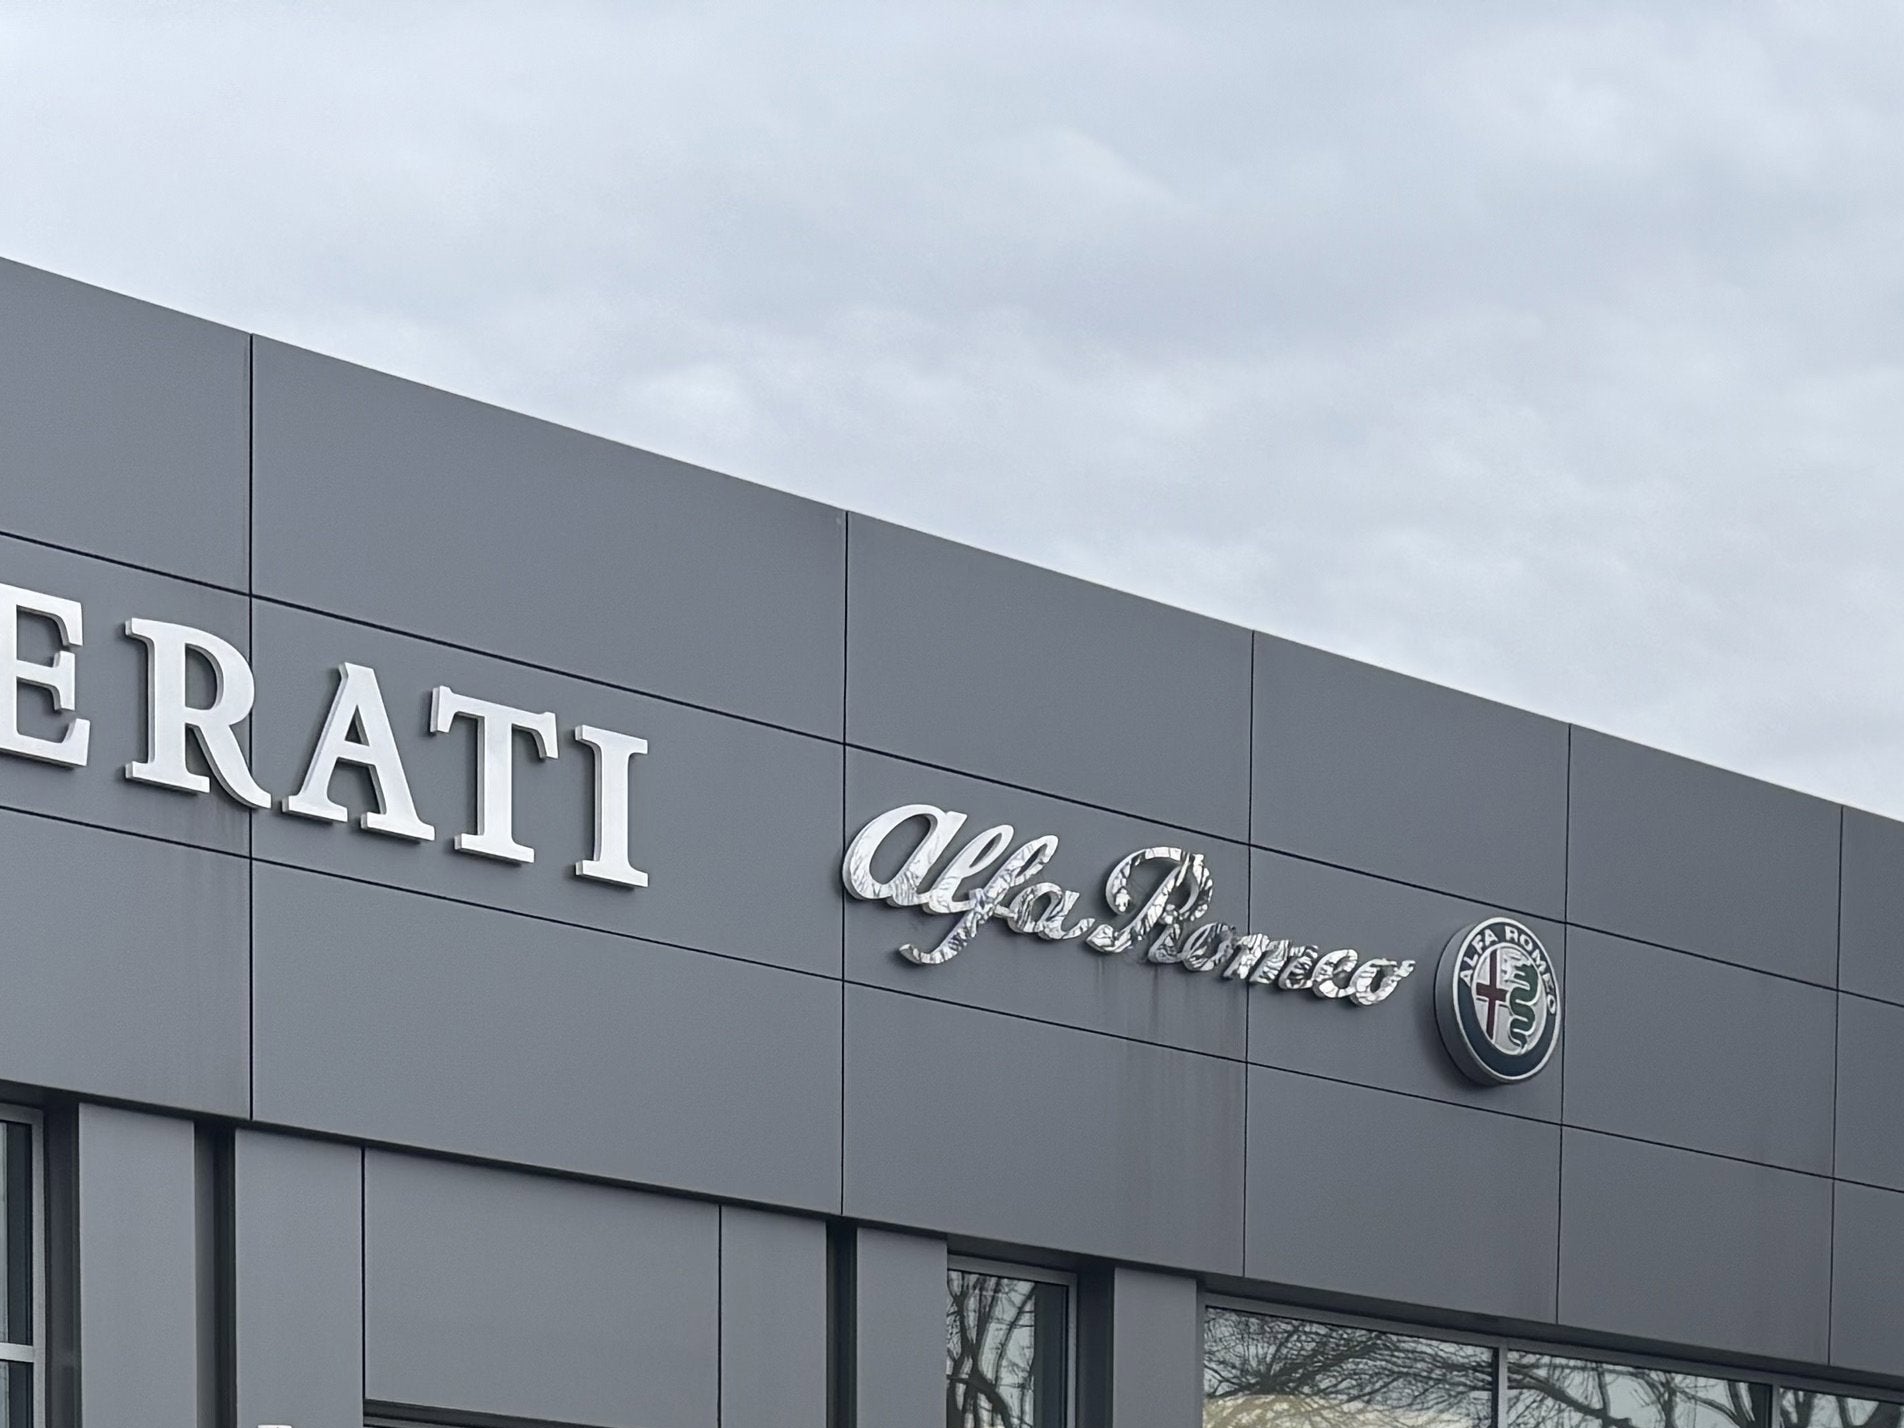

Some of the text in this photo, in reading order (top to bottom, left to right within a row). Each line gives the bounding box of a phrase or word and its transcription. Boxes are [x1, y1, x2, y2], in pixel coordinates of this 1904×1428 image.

[841, 803, 1416, 1008] Alfa Romeo
[1459, 925, 1557, 1016] ALFA ROMEO
